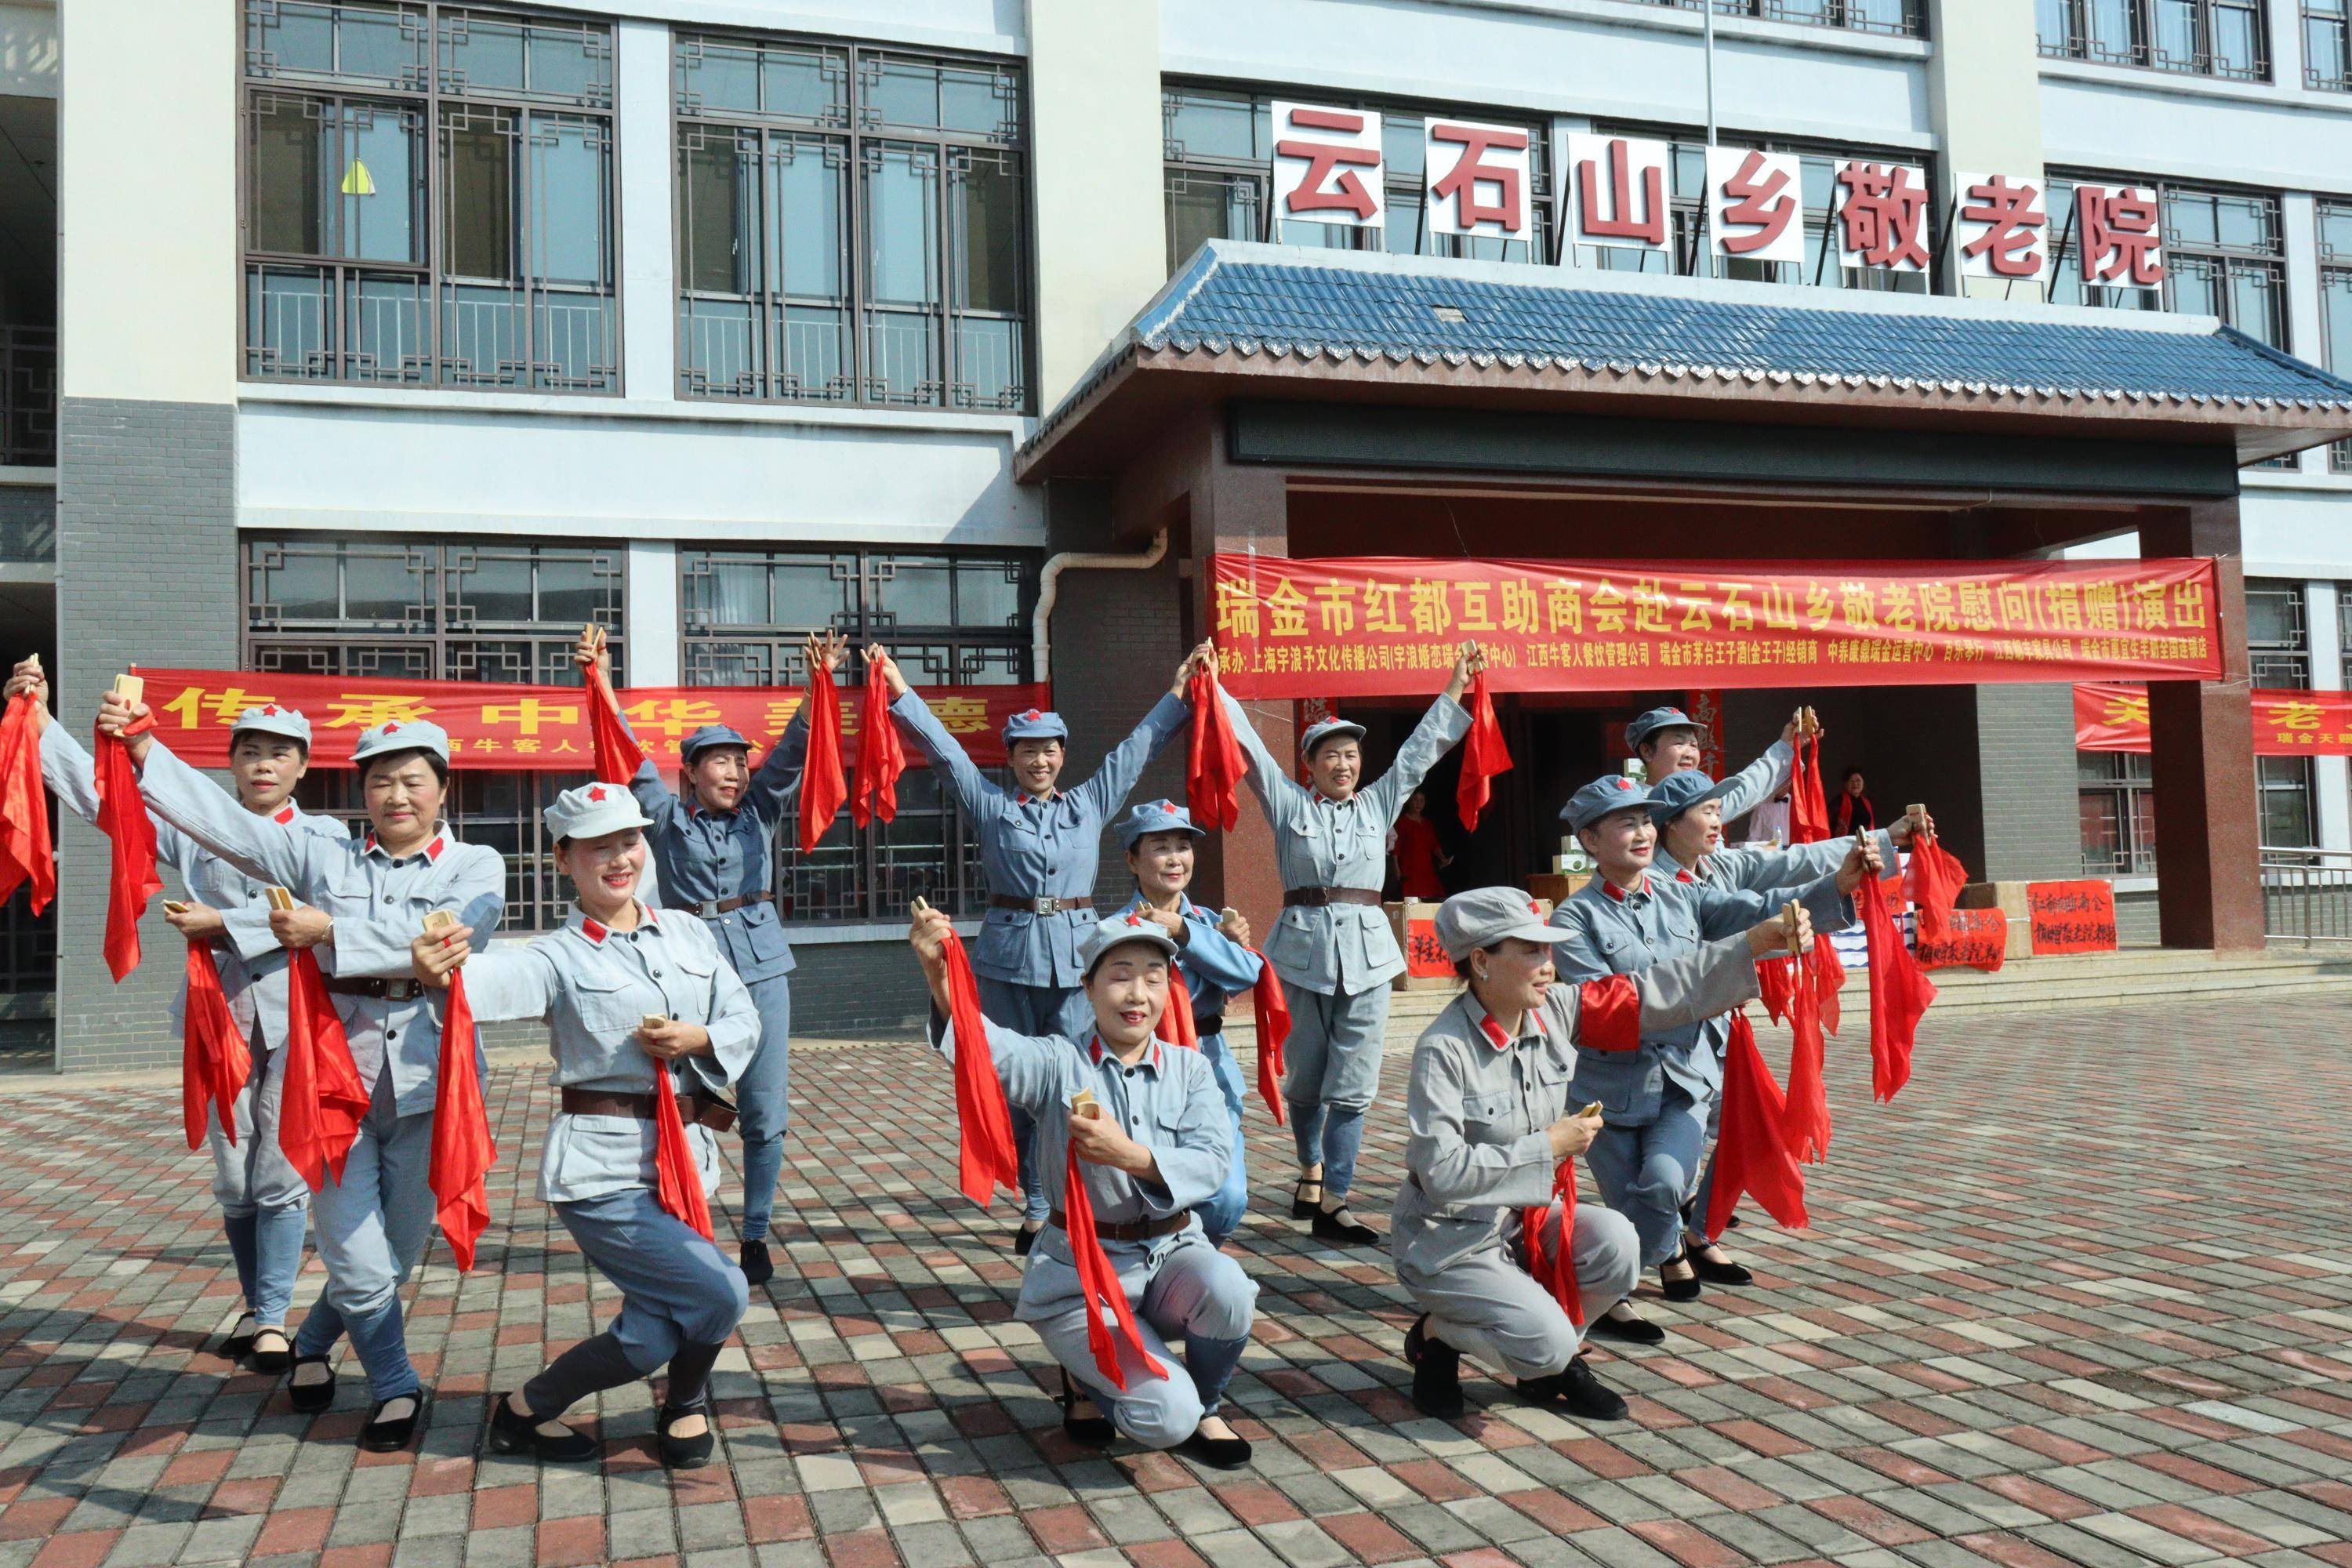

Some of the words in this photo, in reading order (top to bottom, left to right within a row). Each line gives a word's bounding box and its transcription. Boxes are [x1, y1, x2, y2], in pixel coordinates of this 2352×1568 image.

[1276, 107, 2163, 285] 云石山乡敬老院
[1216, 576, 2205, 639] 瑞金市红都互助商会赴云石山乡敬老院慰问(捐赠)演出
[1526, 641, 1650, 668] 江西牛客人餐饮管理公司
